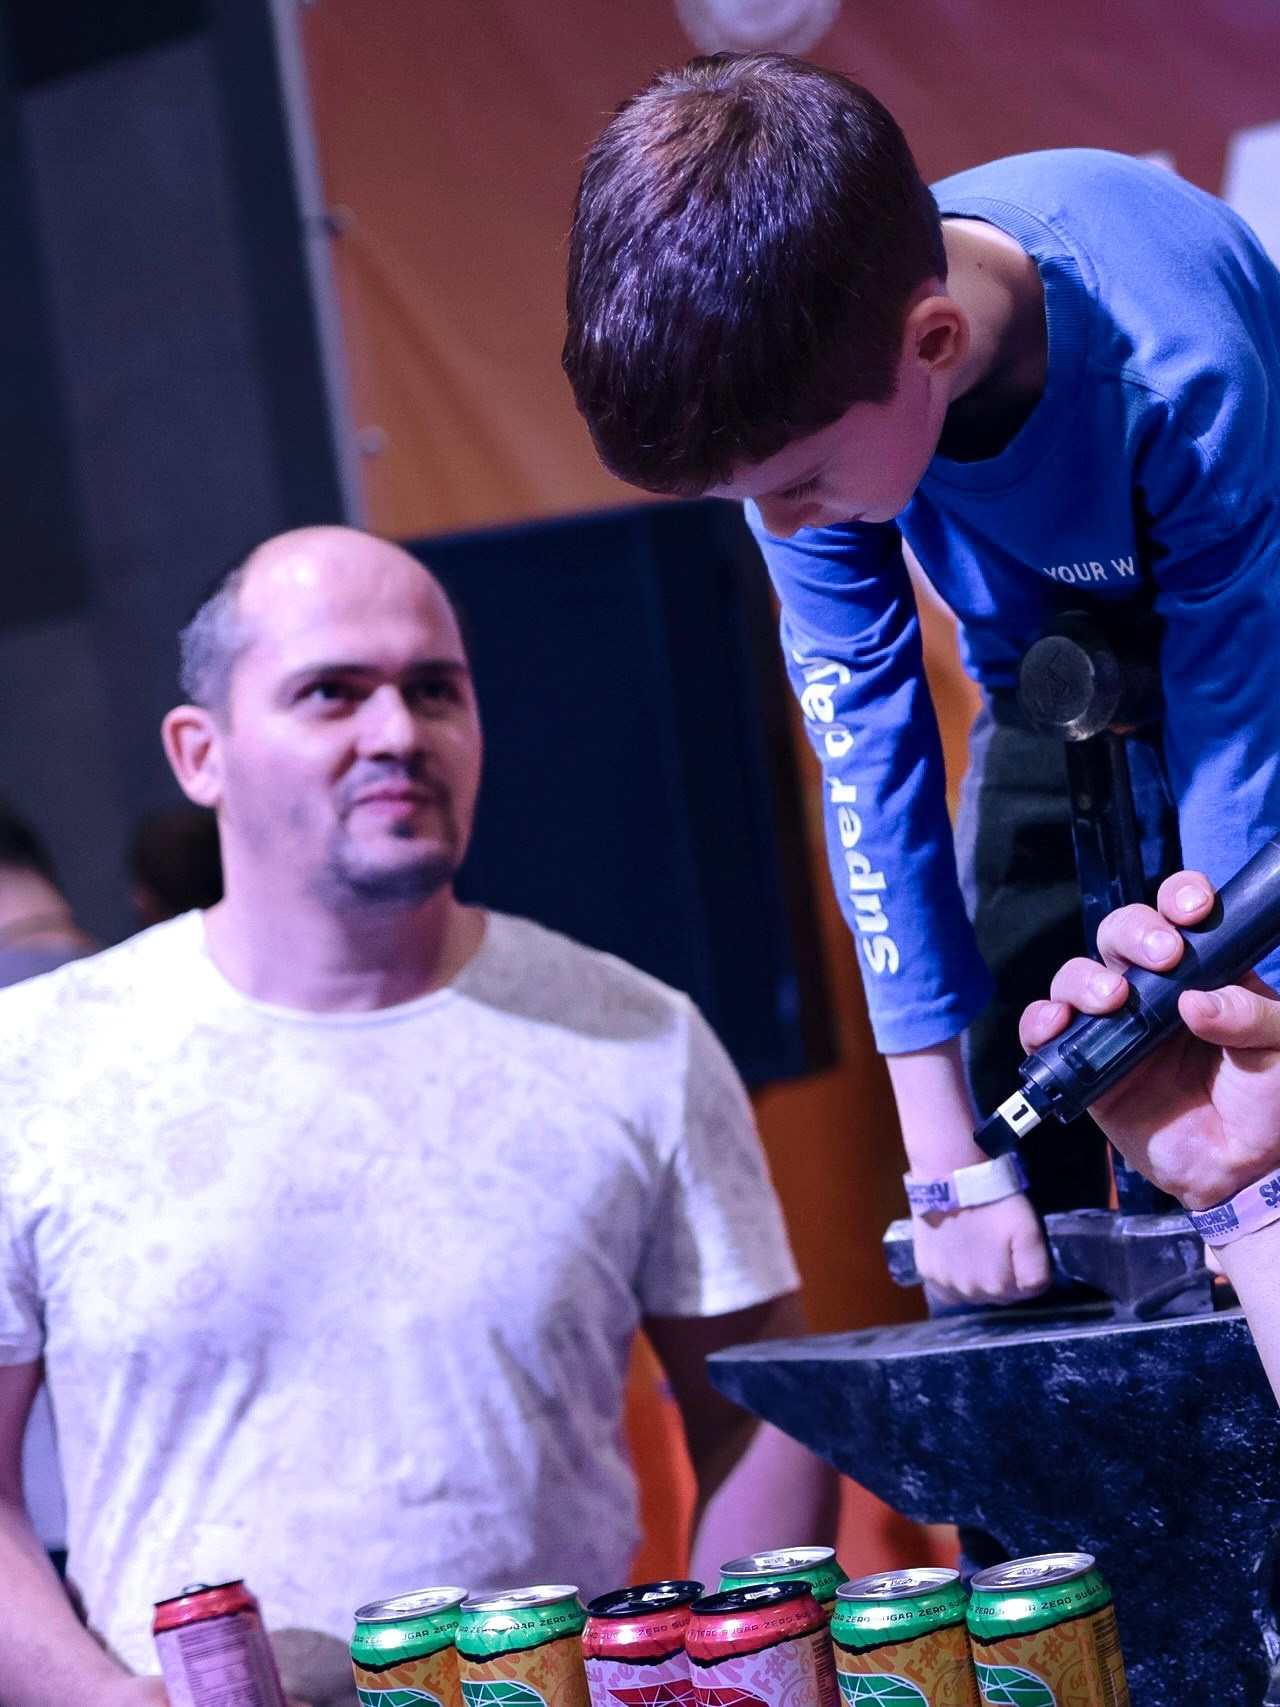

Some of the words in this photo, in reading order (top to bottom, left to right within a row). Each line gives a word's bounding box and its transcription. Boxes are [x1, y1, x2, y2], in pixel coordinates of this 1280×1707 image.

[1042, 561, 1108, 583] YOUR
[791, 648, 854, 759] day
[825, 775, 900, 975] super
[1012, 1103, 1030, 1122] 1
[918, 1604, 947, 1618] ZERO
[1041, 1597, 1072, 1611] ZERO
[433, 1620, 460, 1635] ZERO
[539, 1614, 567, 1627] ZERO
[763, 1616, 794, 1629] ZERO
